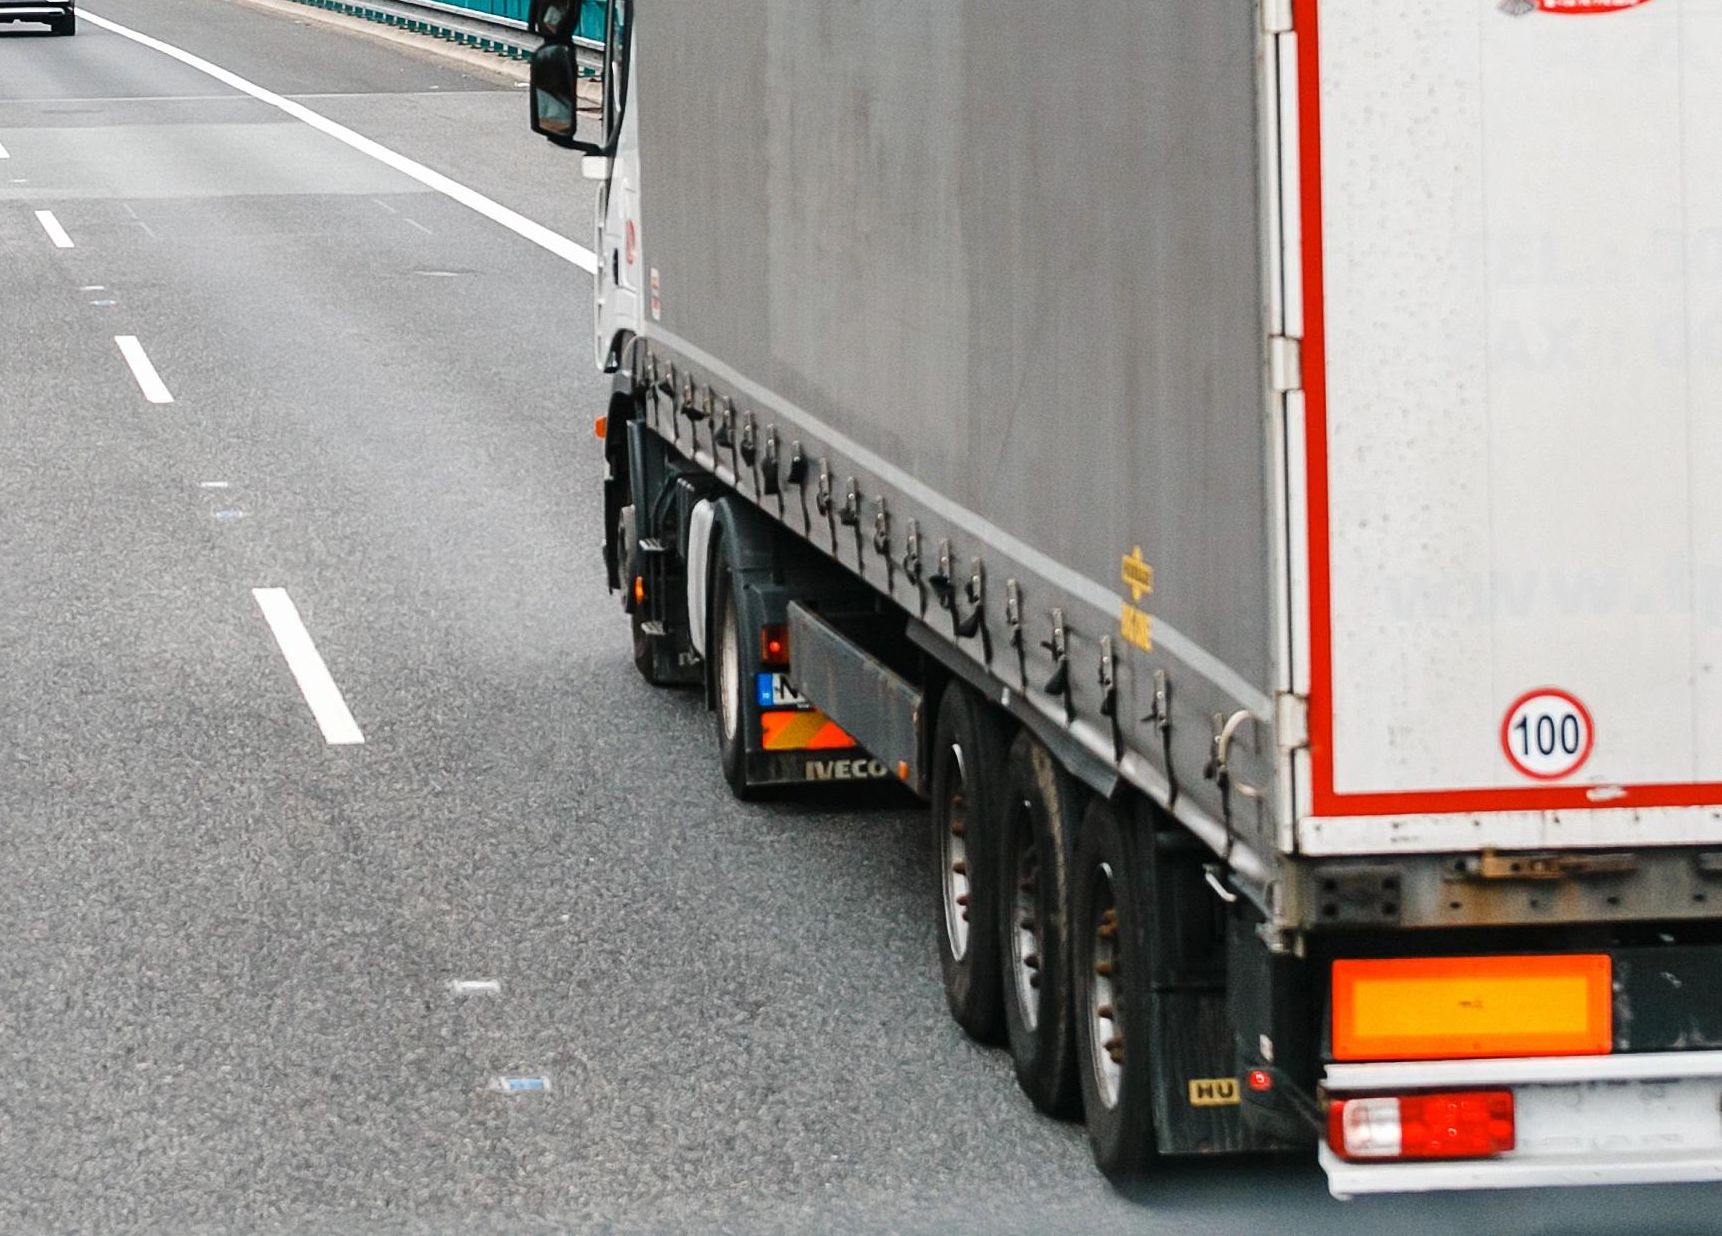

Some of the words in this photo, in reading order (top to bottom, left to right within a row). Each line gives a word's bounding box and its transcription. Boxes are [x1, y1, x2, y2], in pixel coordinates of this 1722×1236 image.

[1513, 713, 1581, 757] 100
[805, 758, 888, 780] IVECO
[1197, 1082, 1235, 1099] HU
